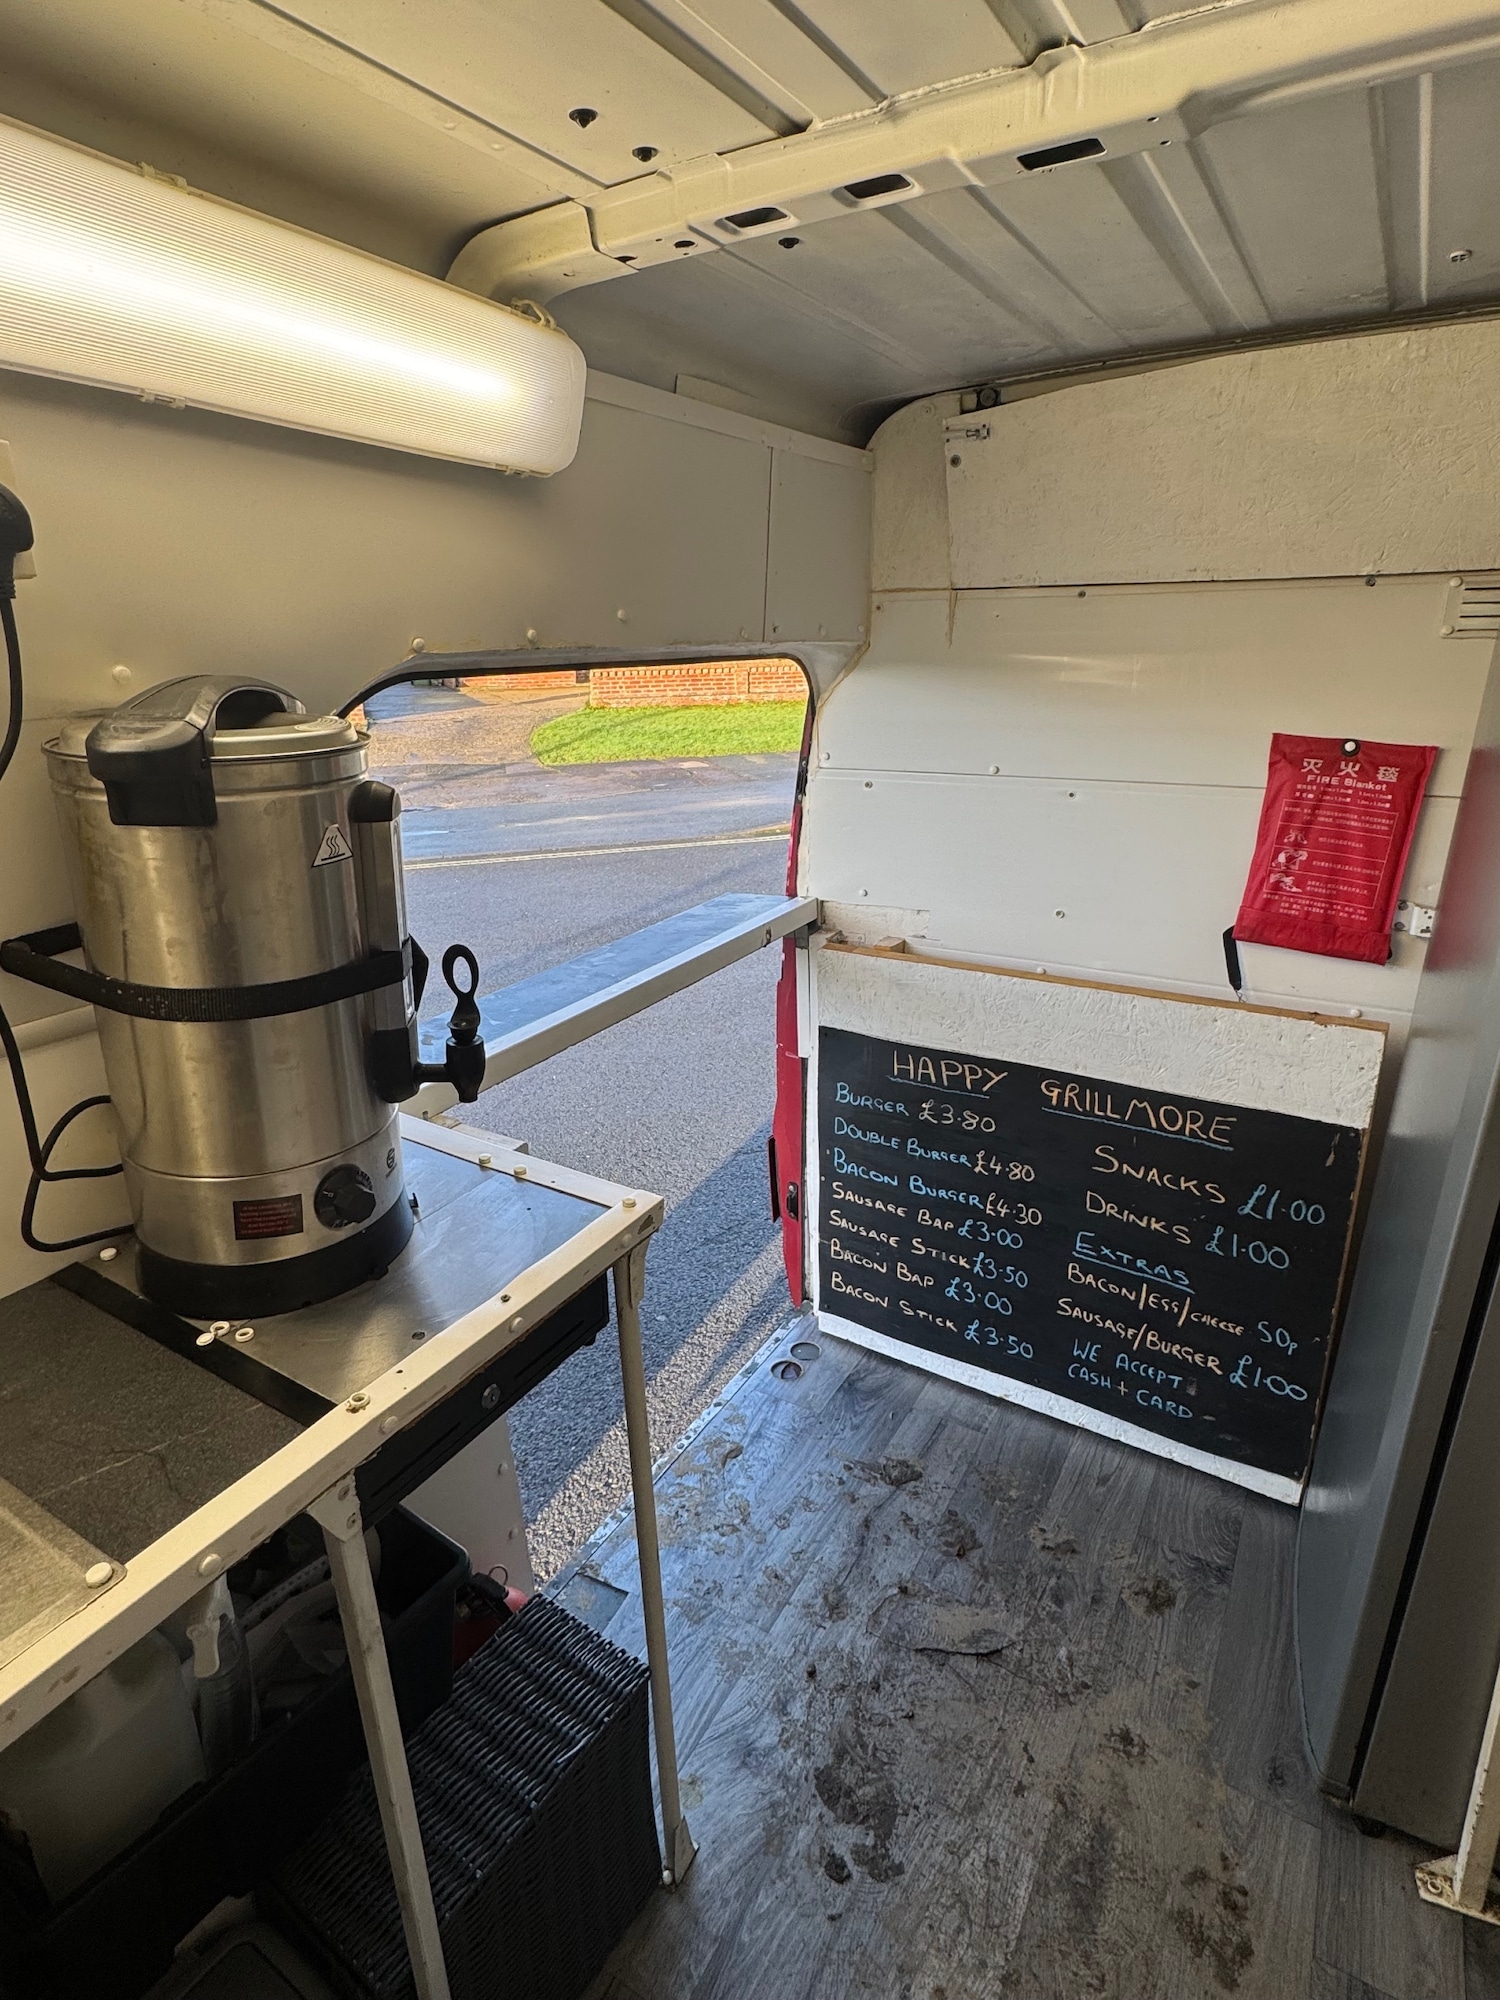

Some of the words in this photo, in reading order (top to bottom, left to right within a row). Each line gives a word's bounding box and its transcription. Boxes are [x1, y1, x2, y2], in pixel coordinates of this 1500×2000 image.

[1301, 758, 1400, 783] 灭火毯
[1306, 774, 1340, 785] FIRE
[1344, 778, 1387, 791] Blanket
[893, 1050, 1008, 1092] HAPPY
[835, 1082, 909, 1117] BURGER
[918, 1099, 996, 1133] £3.80
[1041, 1079, 1237, 1143] GRILLMORE
[834, 1117, 900, 1150] DOUBLE
[907, 1138, 972, 1168] BURGER
[974, 1150, 1035, 1182] £4.80
[832, 1181, 908, 1217] SAUSAGE
[918, 1209, 954, 1231] BAP
[957, 1219, 1023, 1249] £3.00
[833, 1147, 899, 1187] BACON
[909, 1175, 984, 1210] BURGER
[985, 1192, 1042, 1226] £4.30
[1092, 1145, 1226, 1204] SNACKS
[1237, 1183, 1326, 1225] £1.00
[829, 1210, 900, 1248] SAUSAGE
[911, 1238, 971, 1269] STICK
[973, 1252, 1029, 1288] £3.50
[1075, 1231, 1191, 1285] EXTRAS
[1086, 1190, 1192, 1245] DRINKS
[1205, 1225, 1290, 1270] £1.00
[830, 1238, 887, 1273] BACON
[897, 1262, 934, 1288] BAP
[945, 1277, 1013, 1315] £3.00
[831, 1272, 888, 1308] BACON
[899, 1300, 957, 1332] STICK
[964, 1320, 1033, 1359] £3.50
[1068, 1363, 1111, 1389] CASH
[1136, 1389, 1194, 1419] CARD
[1073, 1338, 1102, 1365] WE
[1116, 1353, 1183, 1389] ACCEPT
[1230, 1355, 1308, 1401] £1.00
